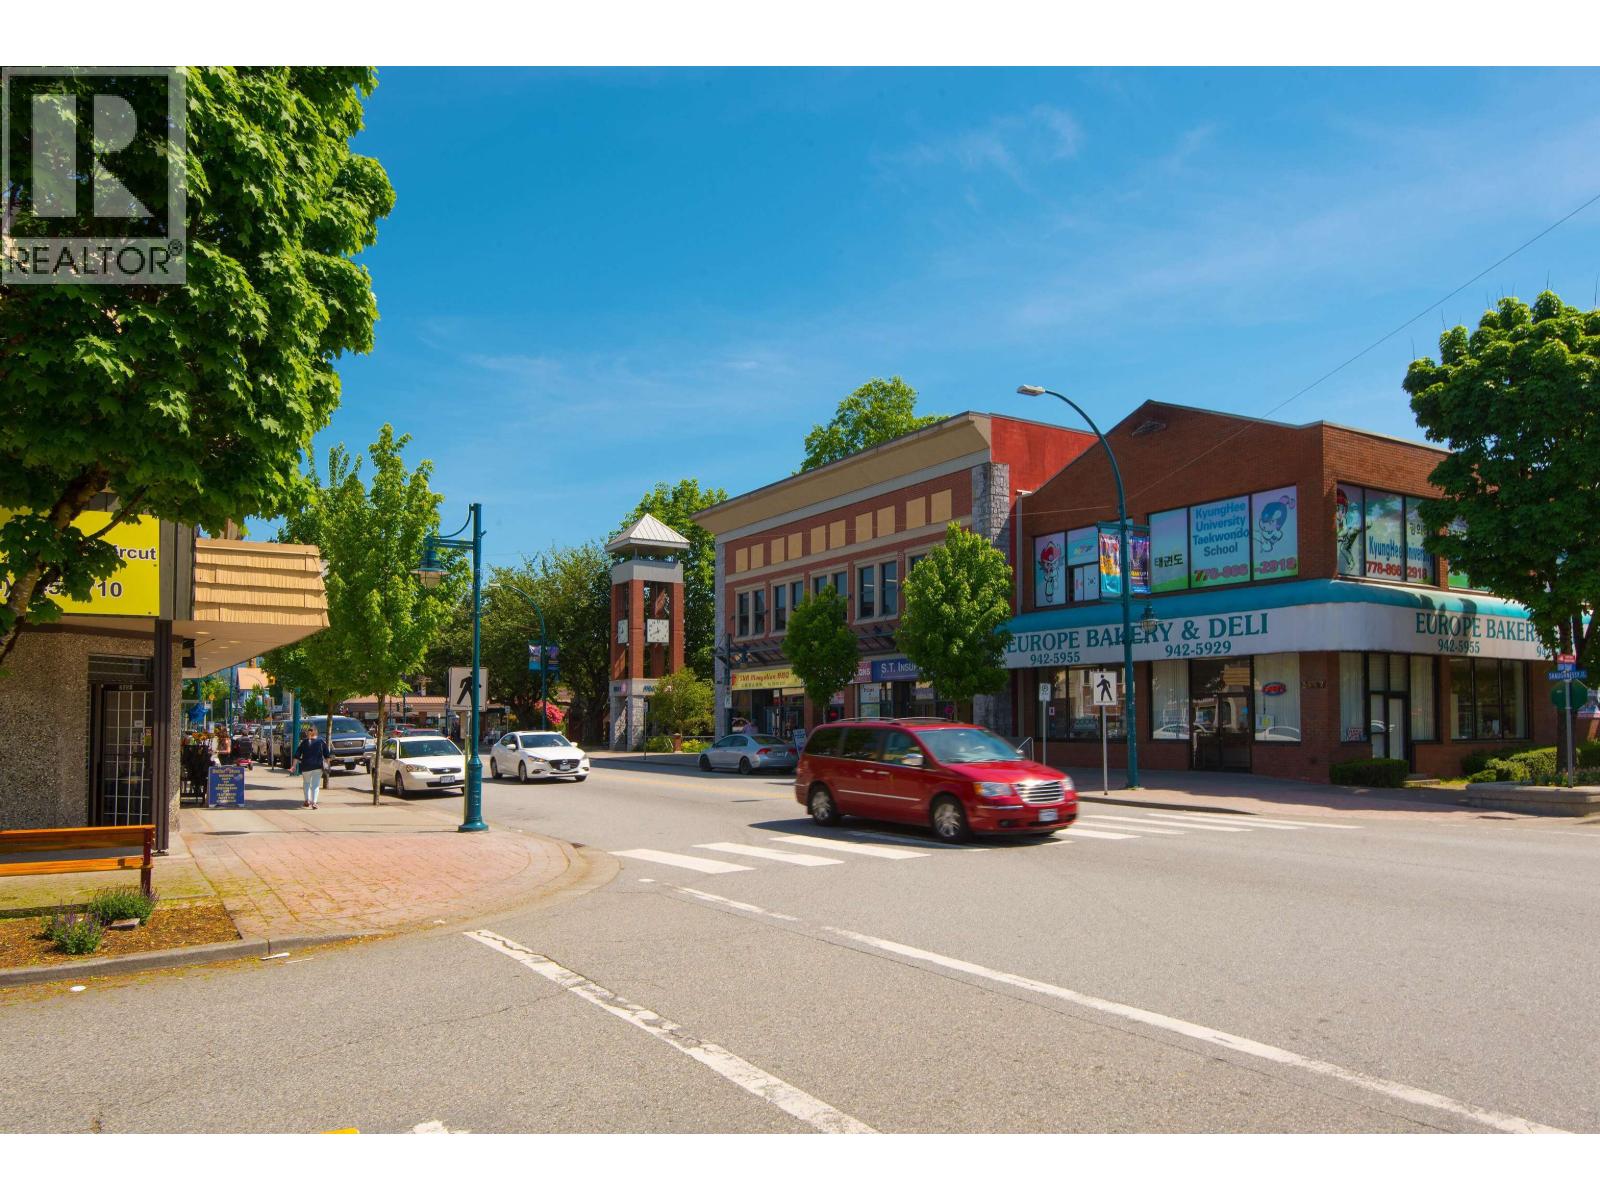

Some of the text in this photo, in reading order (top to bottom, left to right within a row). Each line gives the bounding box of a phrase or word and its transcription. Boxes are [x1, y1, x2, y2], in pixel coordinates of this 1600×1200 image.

[1195, 501, 1246, 520] KyungHee
[1195, 514, 1246, 532] University
[1192, 527, 1249, 545] Taekwondo
[114, 544, 157, 561] ircut
[1203, 541, 1238, 557] School
[1368, 536, 1433, 567] KyungHee niversity
[1007, 631, 1079, 653] EUROPE
[1181, 619, 1200, 640] &
[1208, 612, 1269, 638] DELI
[1416, 612, 1541, 642] EUROPE BAKER
[1030, 640, 1232, 666] 942-5955 942-5929
[1437, 638, 1480, 654] 942-5955
